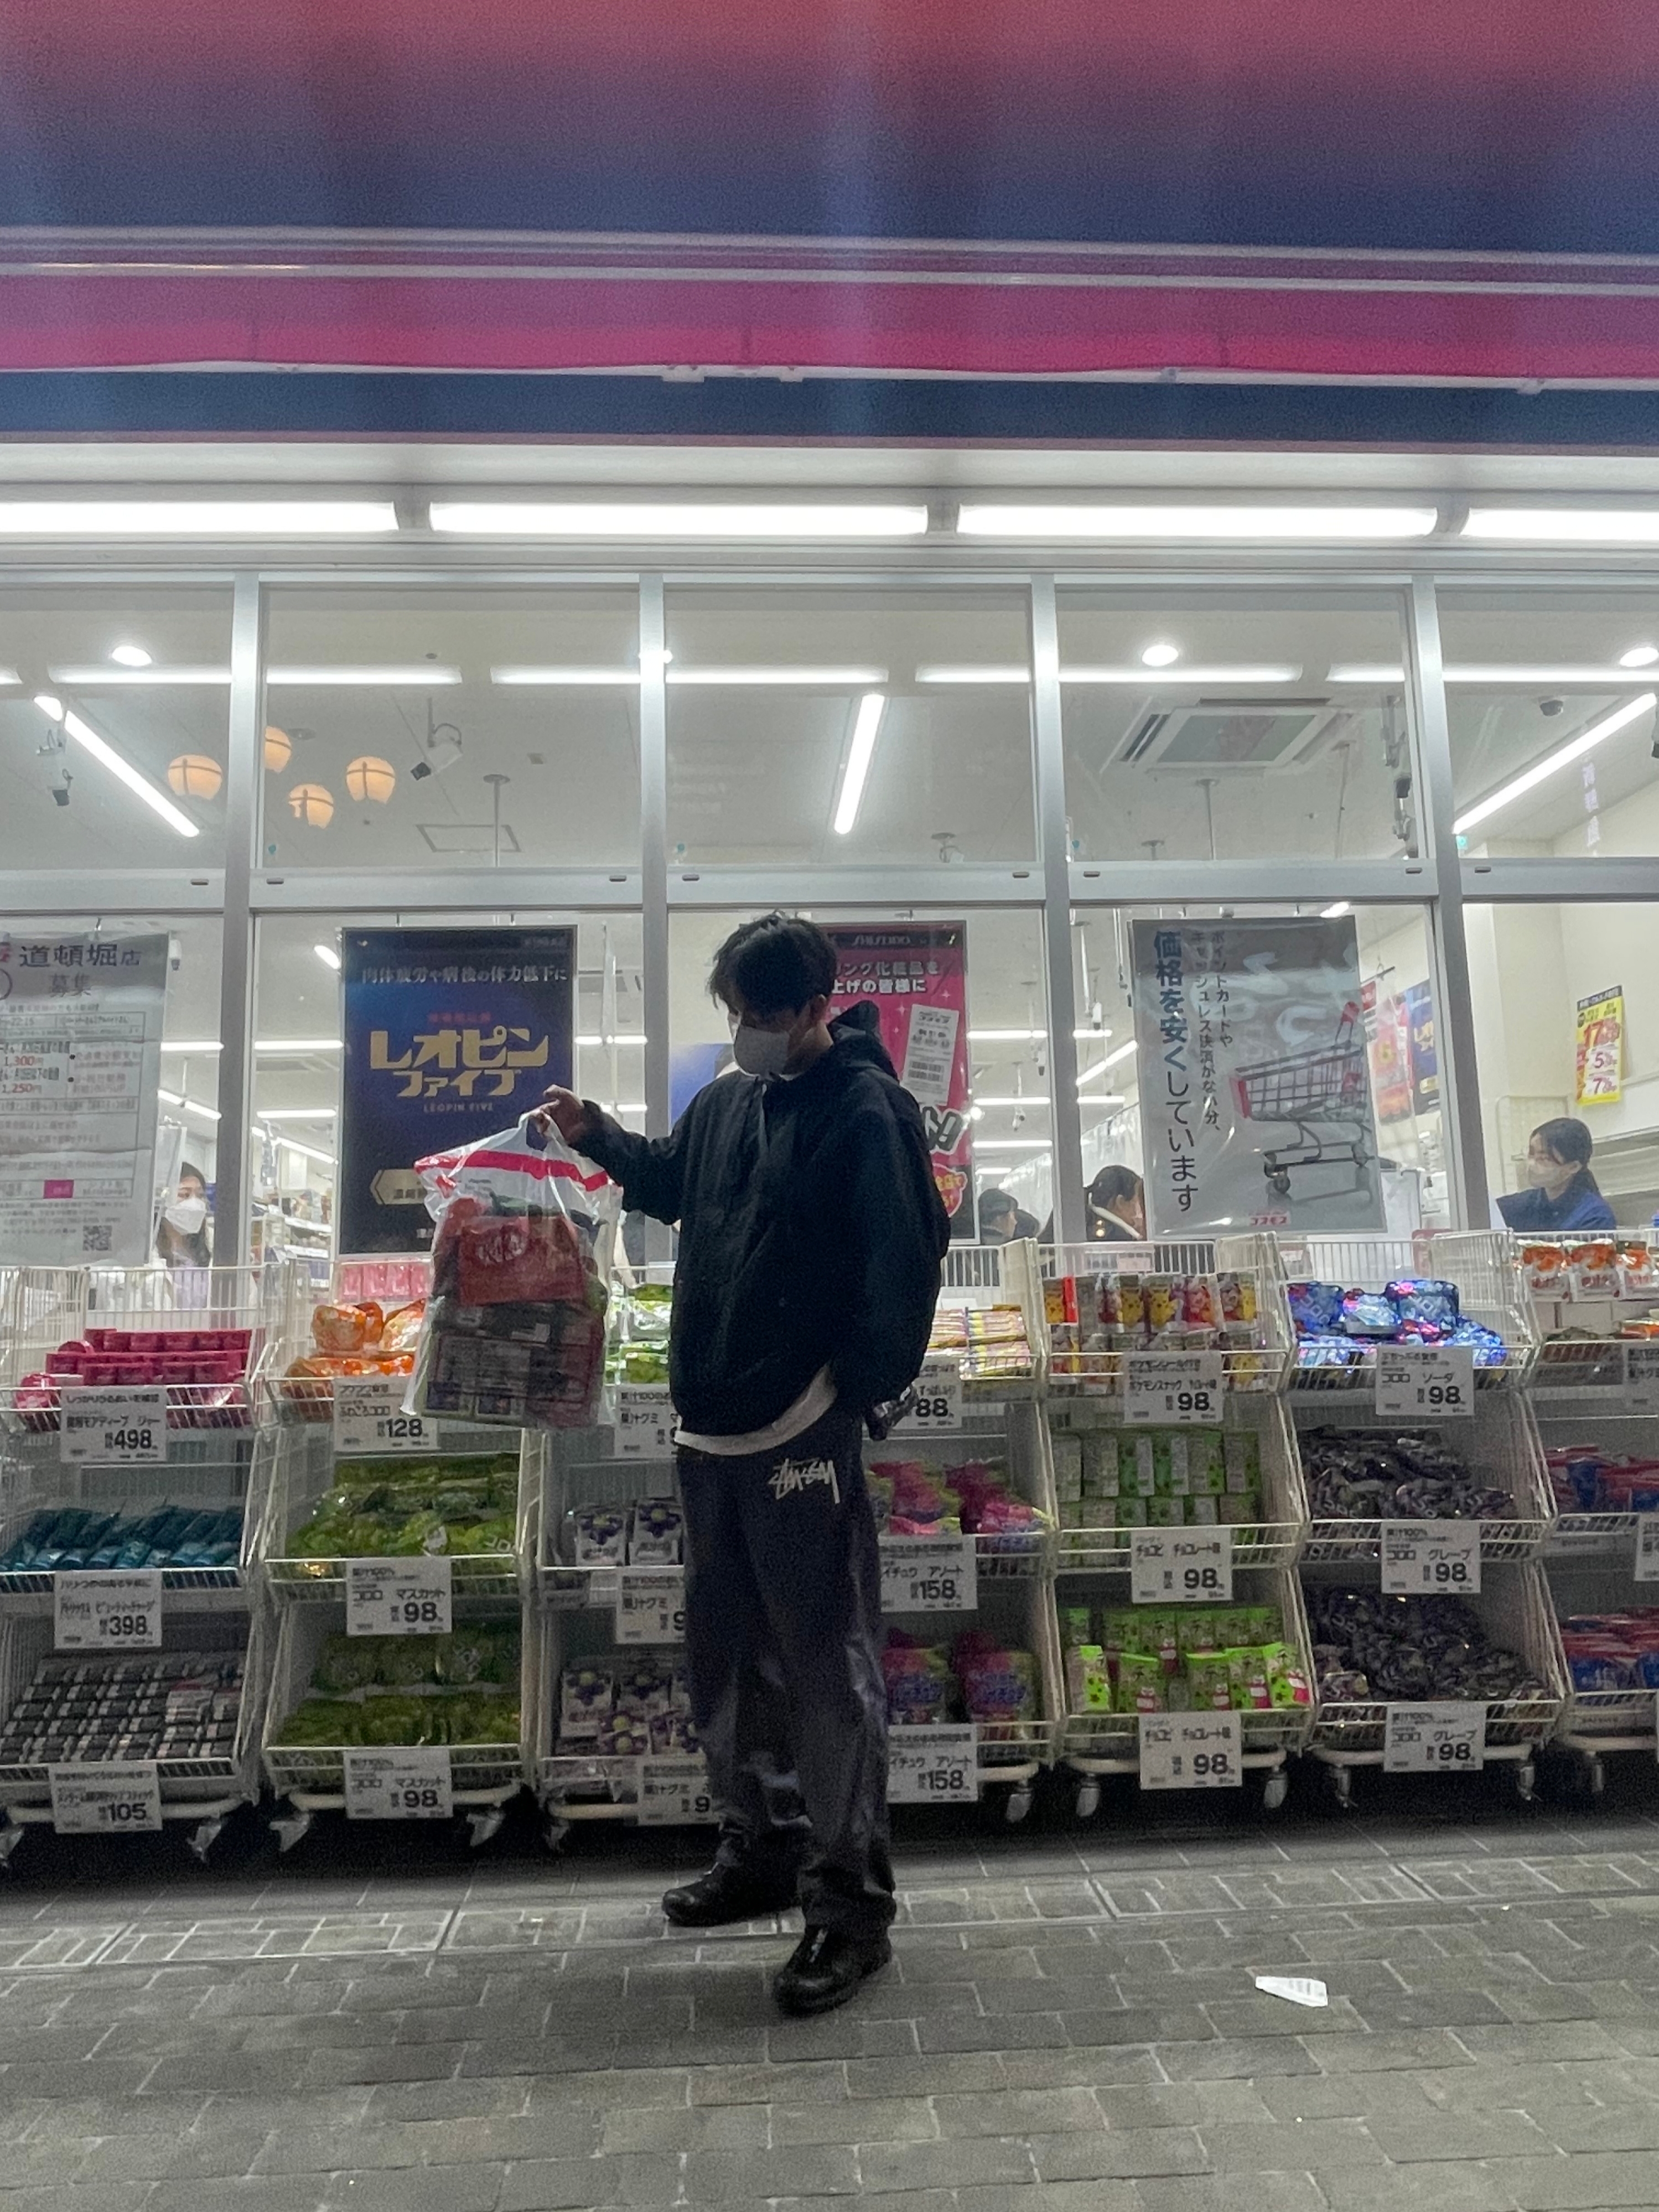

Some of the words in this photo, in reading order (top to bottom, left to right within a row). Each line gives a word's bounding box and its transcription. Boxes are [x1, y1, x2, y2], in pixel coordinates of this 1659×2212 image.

[19, 943, 142, 967] 道頓堀店
[370, 1025, 549, 1069] レオピン
[1154, 930, 1198, 1212] 価格を安くしています
[1422, 1372, 1455, 1384] ソーダ
[1178, 1392, 1210, 1411] 98
[1429, 1385, 1461, 1404] 98
[386, 1418, 423, 1438] 128
[114, 1429, 152, 1450] 498
[1428, 1549, 1471, 1561] グレープ
[927, 1565, 964, 1578] アソート
[1184, 1567, 1218, 1590] 98
[1435, 1562, 1466, 1583] 98
[920, 1580, 956, 1600] 158
[404, 1601, 438, 1623] 98
[109, 1615, 148, 1636] 398
[1433, 1730, 1477, 1742] グレープ
[936, 1754, 972, 1770] アソート
[1439, 1743, 1471, 1761] 98
[1193, 1753, 1228, 1775] 98
[927, 1769, 964, 1790] 158
[403, 1789, 438, 1809] 98
[107, 1802, 147, 1821] 105
